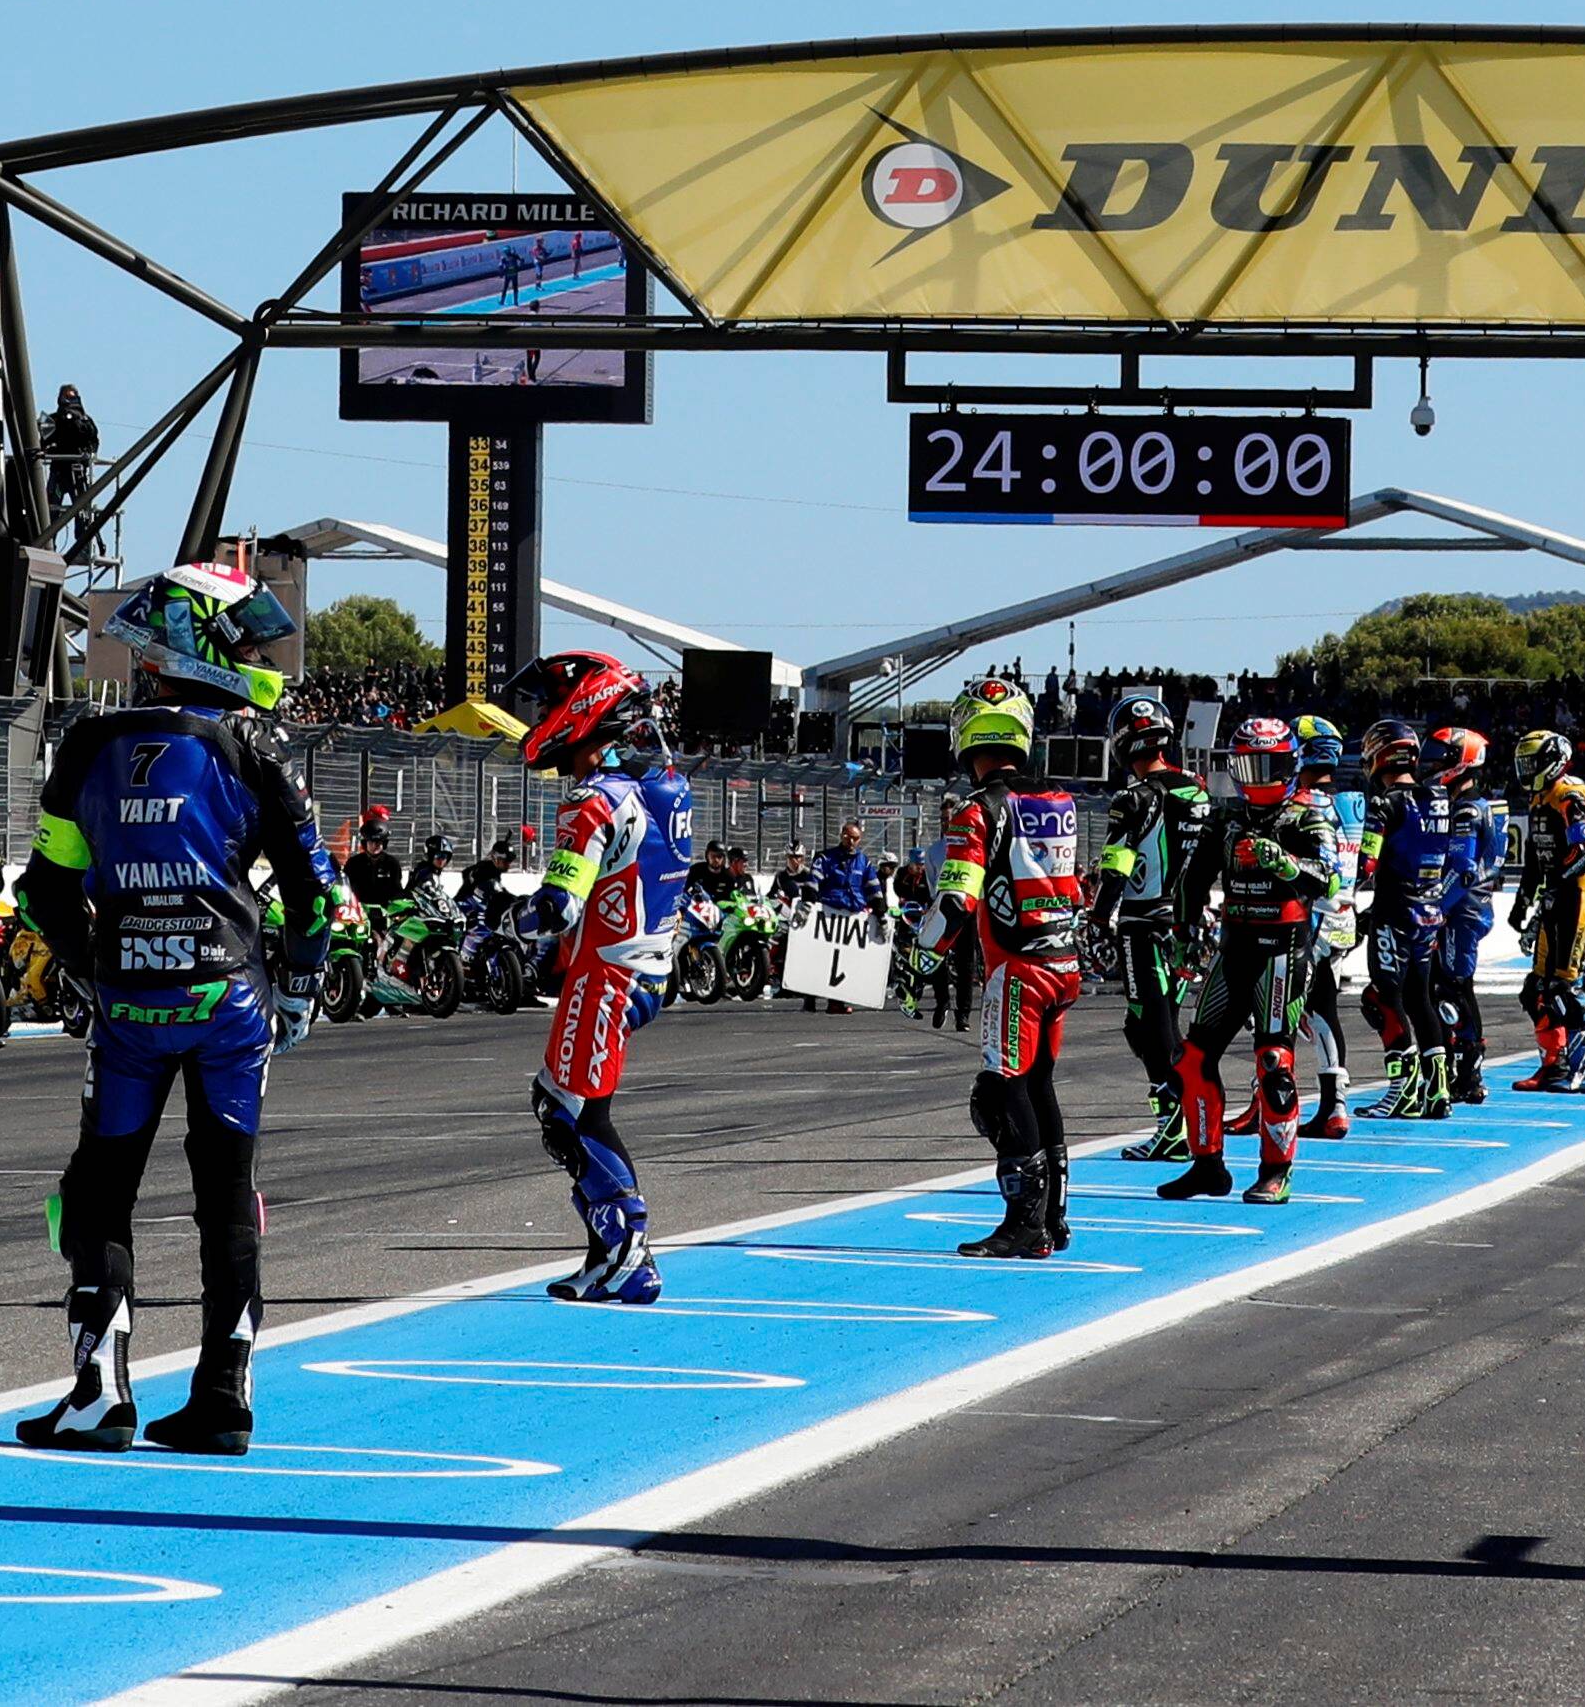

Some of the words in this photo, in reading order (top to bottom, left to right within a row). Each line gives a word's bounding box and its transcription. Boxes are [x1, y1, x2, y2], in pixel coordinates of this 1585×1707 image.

[883, 167, 958, 205] D
[392, 203, 507, 221] RICHARD
[517, 204, 595, 221] MILLE
[470, 437, 489, 451] 33
[470, 458, 489, 472] 34
[925, 428, 1332, 497] 24:00:00
[470, 479, 489, 492] 35
[470, 499, 488, 512] 36
[469, 519, 488, 533] 37
[469, 539, 487, 553] 38
[469, 559, 487, 573] 39
[468, 580, 486, 593] 40
[467, 600, 485, 613] 41
[467, 620, 486, 634] 42
[467, 641, 486, 654] 43
[467, 661, 485, 674] 44
[571, 682, 625, 715] SHARK
[130, 742, 171, 787] 7
[119, 797, 185, 823] YART
[867, 807, 901, 816] DUCATI
[1429, 800, 1450, 816] 33
[115, 861, 212, 889] YAMAHA
[142, 894, 184, 907] YAMALUBE
[119, 915, 214, 933] BRIDGESTONE
[814, 910, 867, 949] MIN
[1376, 924, 1396, 972] IGOL
[828, 949, 846, 988] 1
[1122, 934, 1139, 999] Kawasaki
[110, 1001, 195, 1025] FRITZ
[189, 980, 230, 1022] 7
[558, 971, 590, 1087] HONDA
